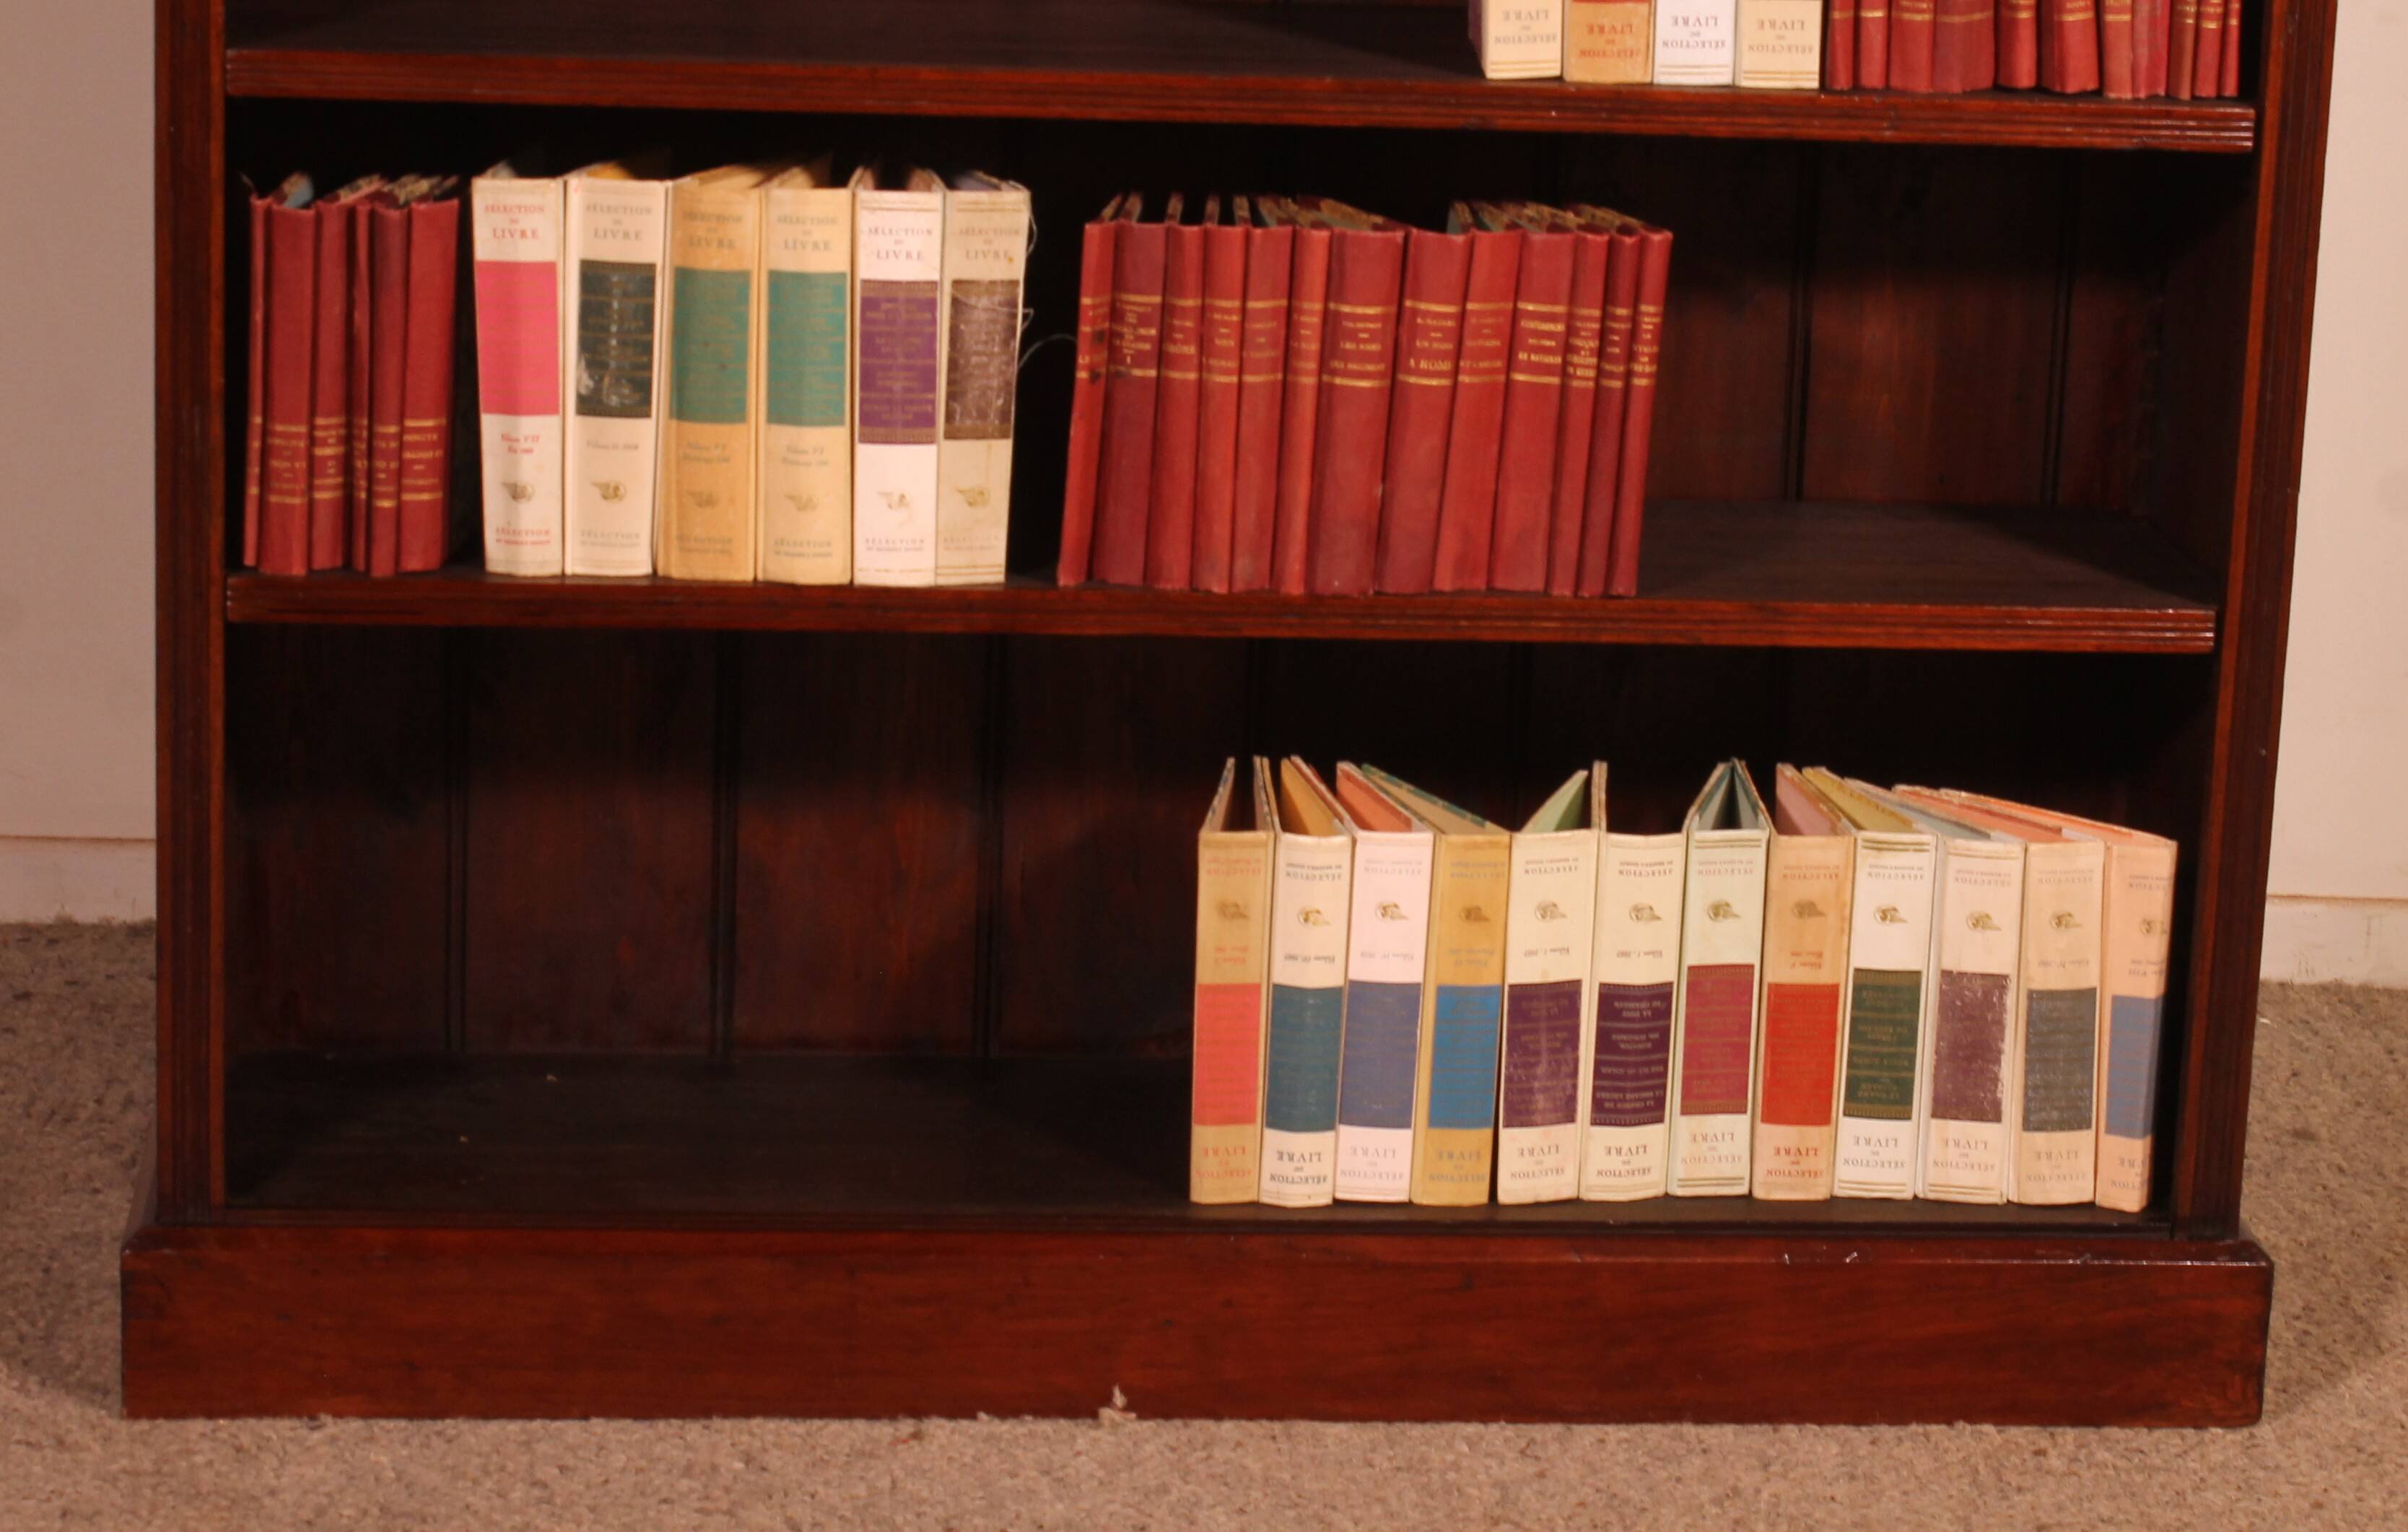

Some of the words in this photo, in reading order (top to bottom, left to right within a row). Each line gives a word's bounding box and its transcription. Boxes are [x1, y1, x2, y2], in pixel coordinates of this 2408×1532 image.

[1503, 9, 1549, 21] LIVRE
[1672, 16, 1718, 27] LIVRE
[1757, 19, 1805, 31] LIVRE
[1587, 23, 1633, 35] LIVRE
[493, 228, 540, 240] LIVRE
[594, 228, 642, 241] LIVRE
[785, 239, 832, 251] LIVRE
[876, 249, 924, 261] LIVRE
[1691, 1131, 1735, 1143] LIVRE
[1853, 1135, 1898, 1148] LIVRE
[1944, 1136, 1988, 1150] LIVRE
[1202, 1145, 1246, 1158] LIVRE
[1277, 1150, 1322, 1163] LIVRE
[1351, 1146, 1396, 1158] LIVRE
[1517, 1144, 1560, 1157] LIVRE
[1605, 1144, 1648, 1157] LIVRE
[1774, 1146, 1819, 1157] LIVRE
[2034, 1150, 2079, 1162] LIVRE
